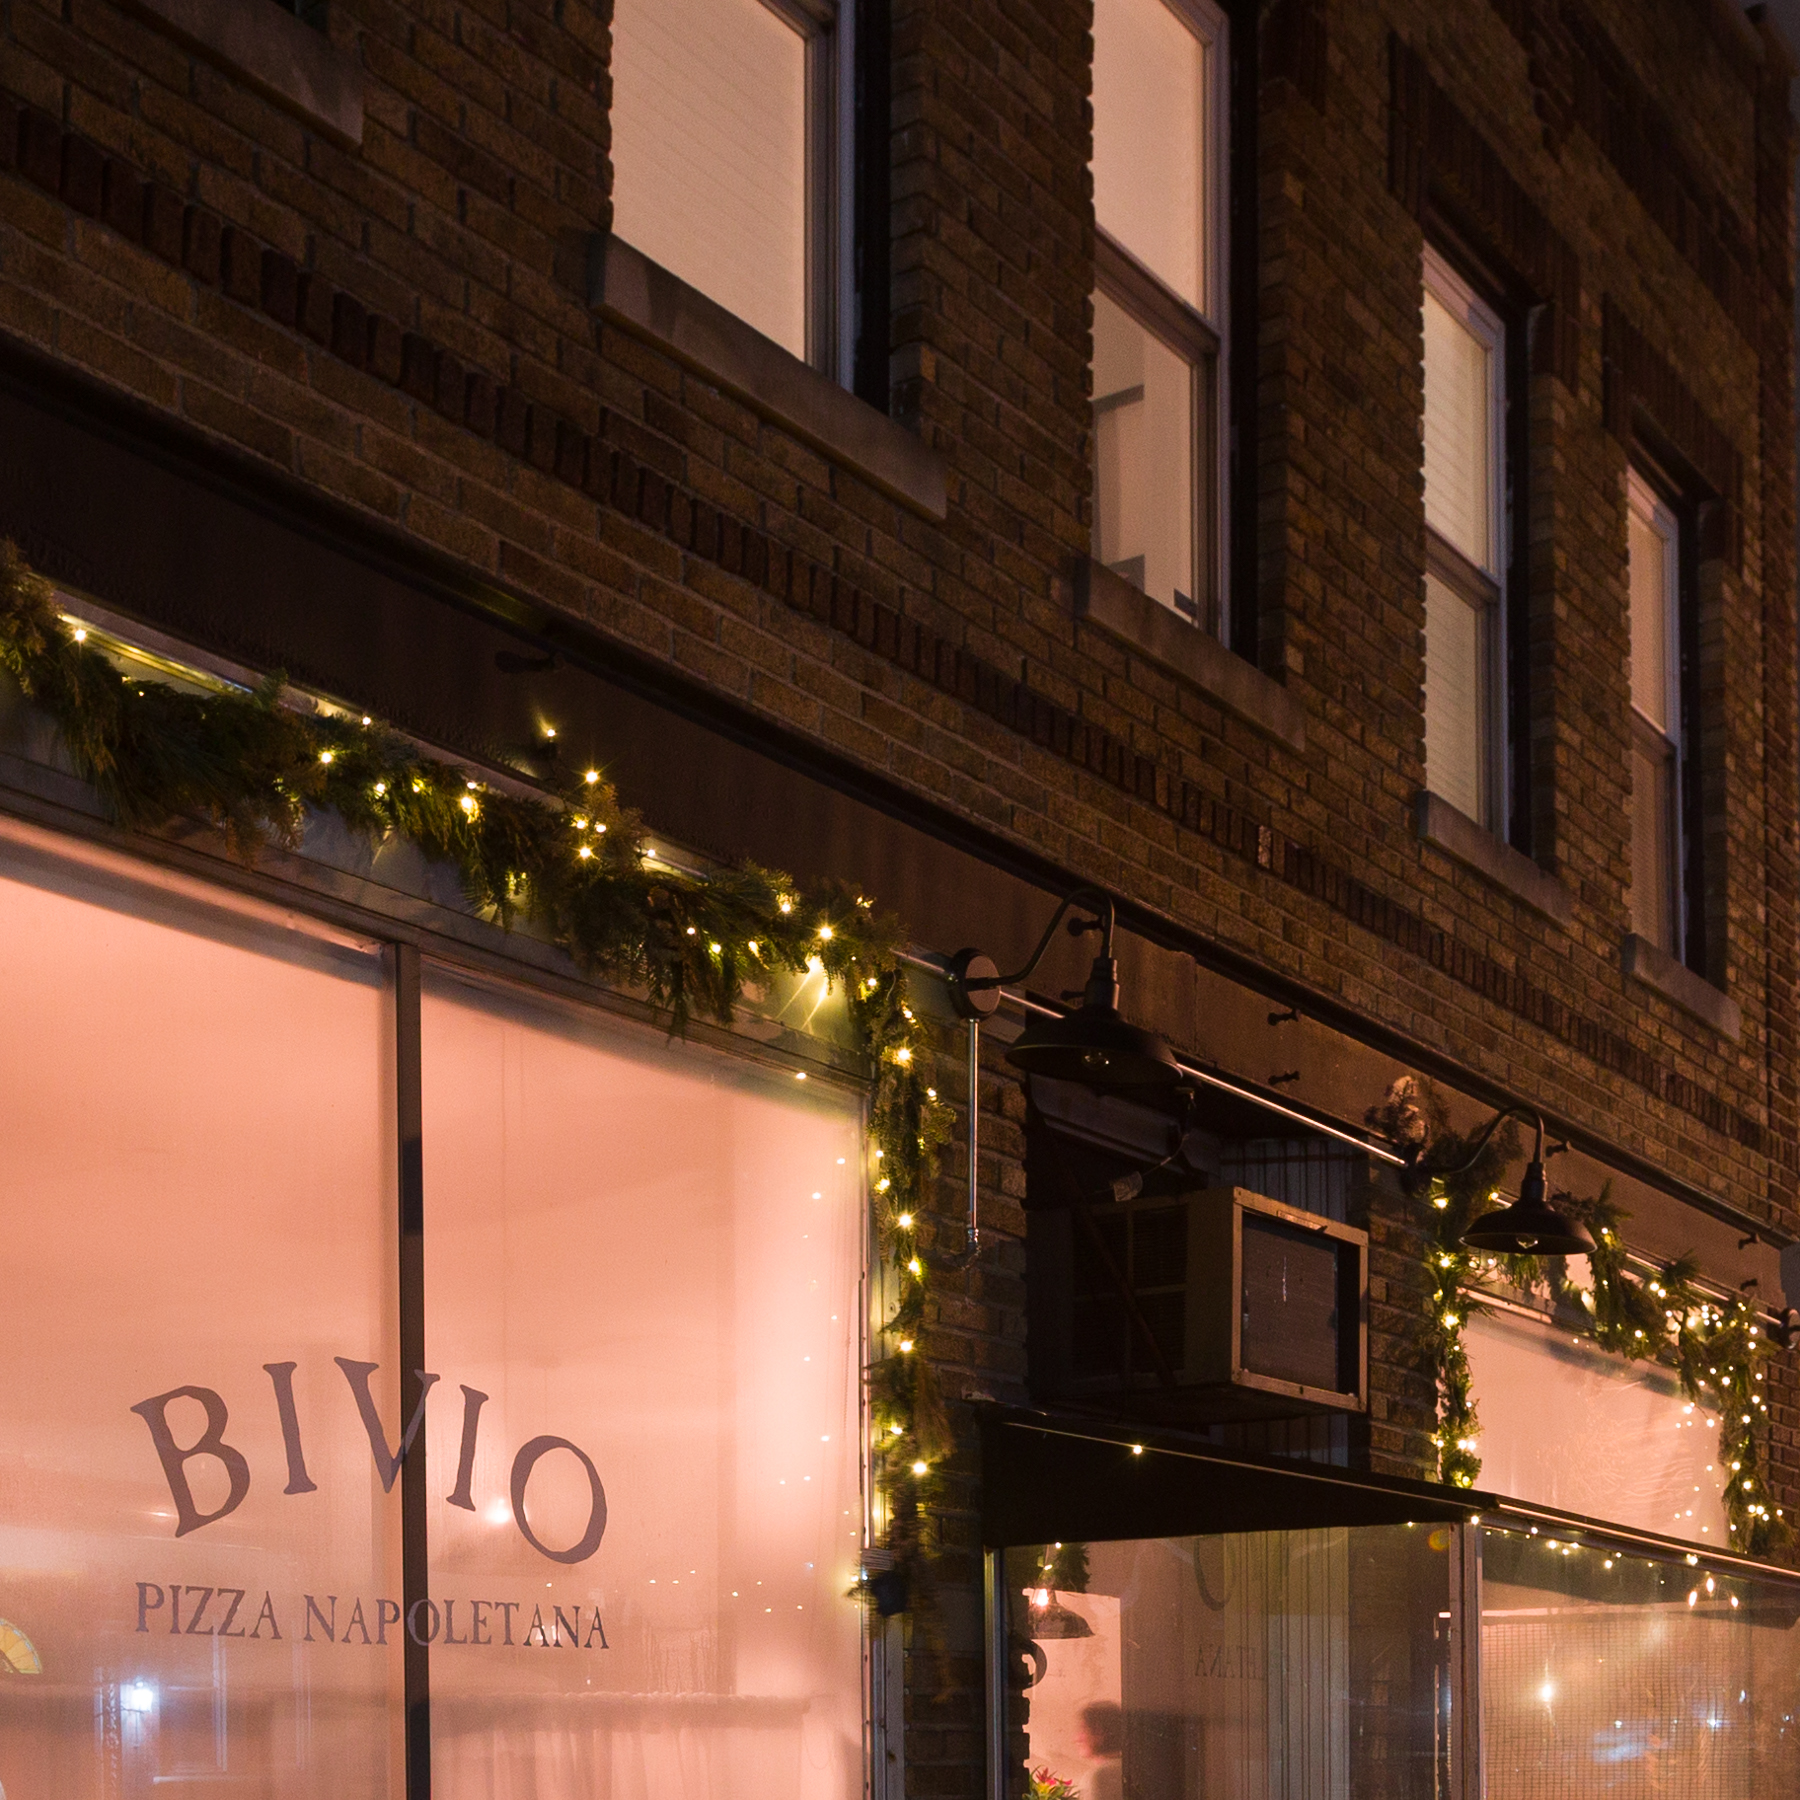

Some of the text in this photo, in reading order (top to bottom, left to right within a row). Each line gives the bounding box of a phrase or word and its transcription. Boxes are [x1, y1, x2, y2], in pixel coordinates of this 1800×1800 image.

[131, 1357, 608, 1565] BIVIO
[136, 1583, 609, 1649] PIZZA NAPOLETANA
